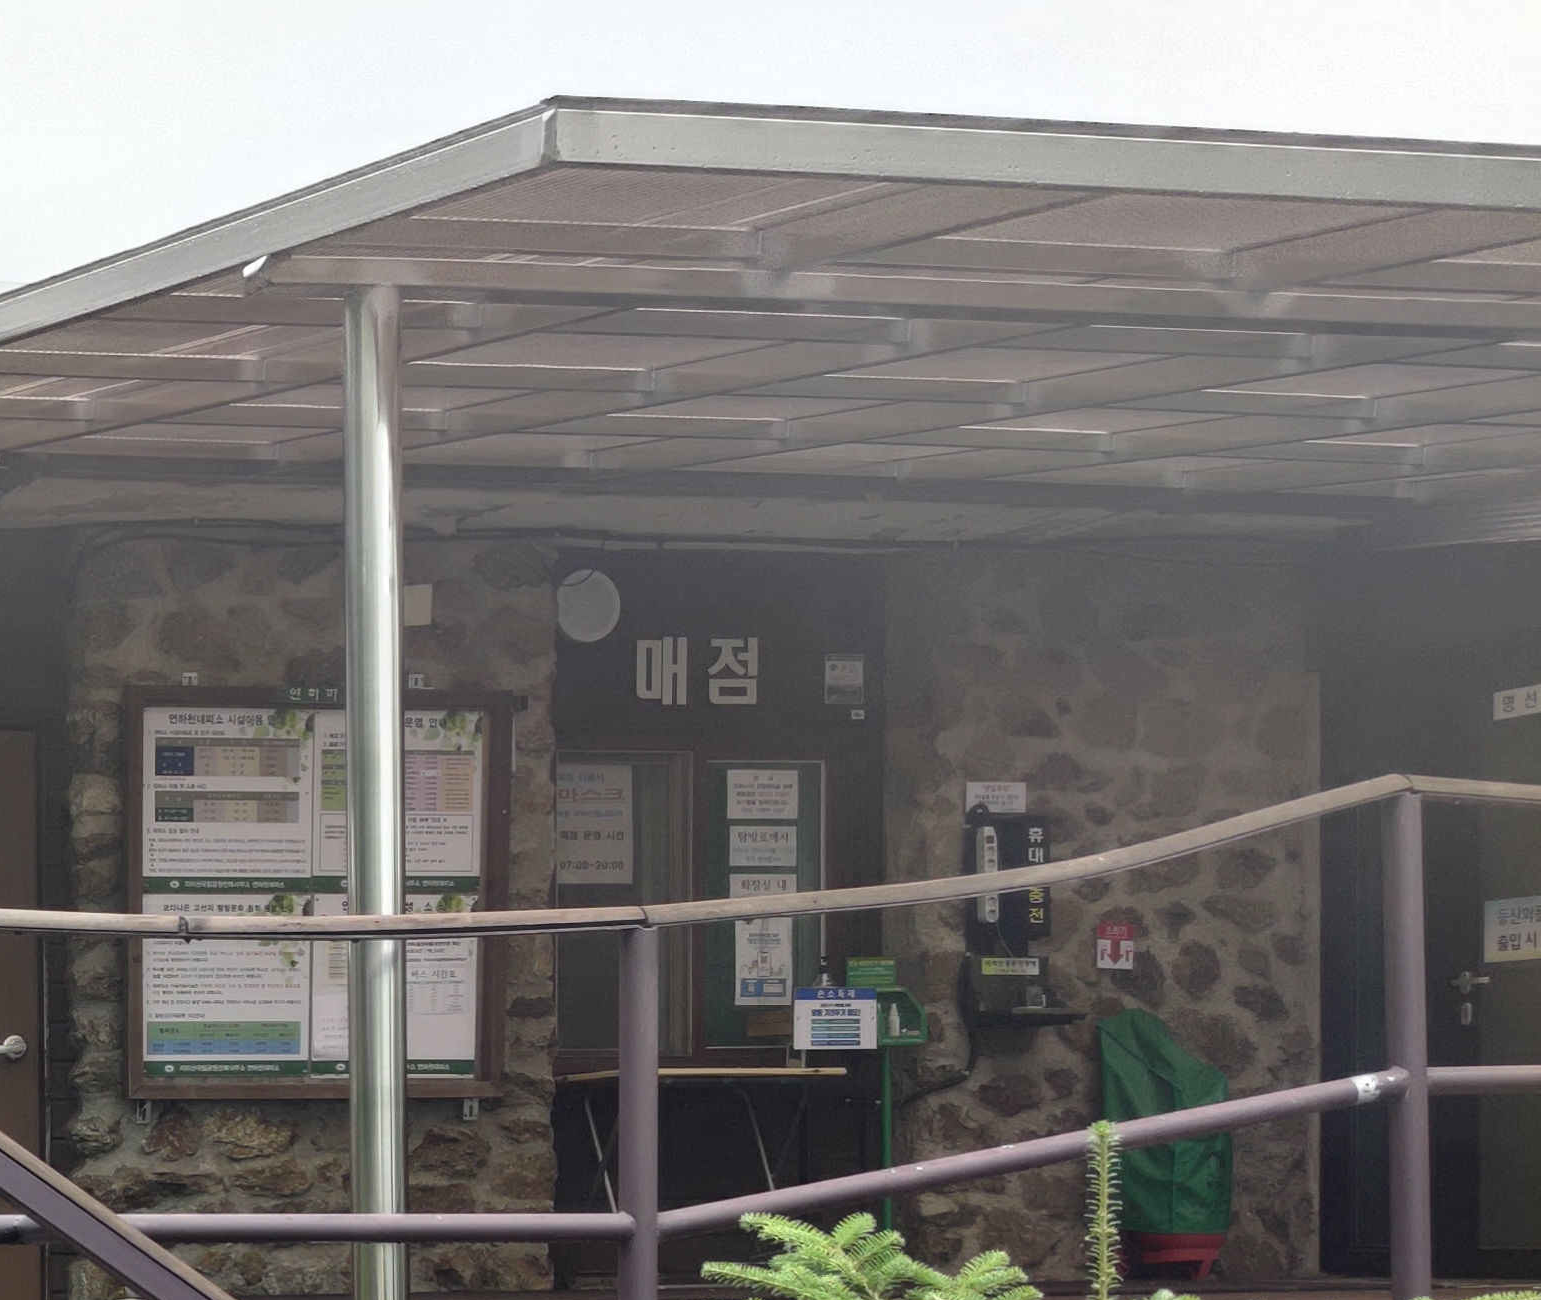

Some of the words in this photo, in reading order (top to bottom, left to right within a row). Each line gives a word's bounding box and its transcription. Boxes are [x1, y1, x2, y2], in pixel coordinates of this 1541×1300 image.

[636, 636, 759, 706] 매점
[168, 713, 223, 725] 연하천대피소
[228, 714, 263, 726] 시설이용
[558, 788, 625, 802] 마스크
[606, 831, 624, 841] 시간
[817, 989, 856, 999] 손소독제
